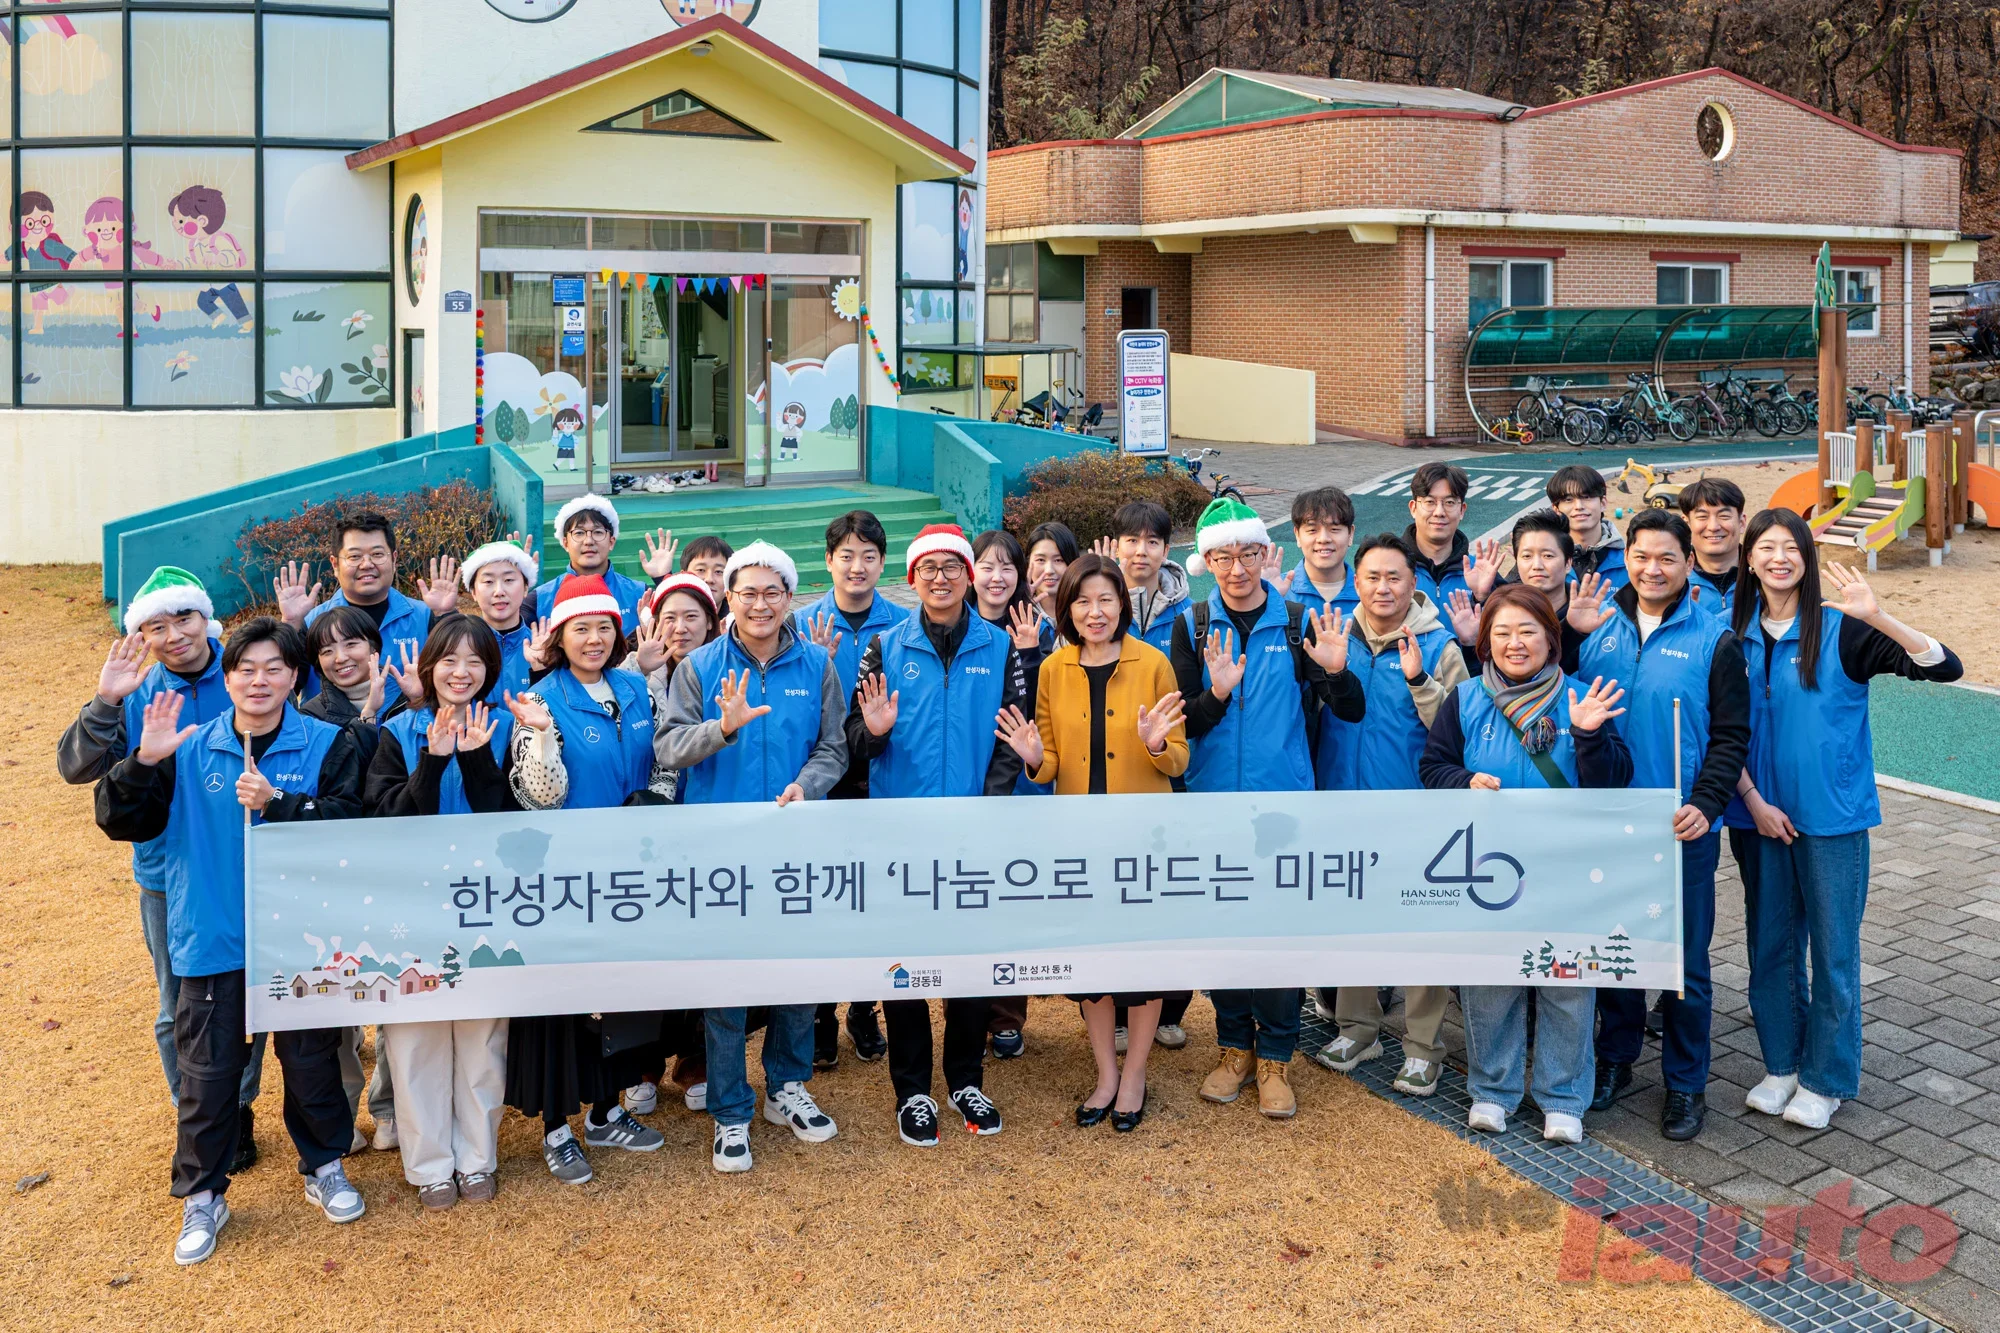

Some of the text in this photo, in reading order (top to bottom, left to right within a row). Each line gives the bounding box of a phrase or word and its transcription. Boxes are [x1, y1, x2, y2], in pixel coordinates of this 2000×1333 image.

[452, 301, 465, 310] 55
[1660, 648, 1689, 660] 한성자동차
[449, 850, 1380, 928] 한성자동차와 함께 ‘나눔으로 만드는 미래’
[1401, 889, 1461, 898] HAN SUNG
[1401, 899, 1460, 907] 40th Anniversary
[911, 975, 942, 988] 경동원
